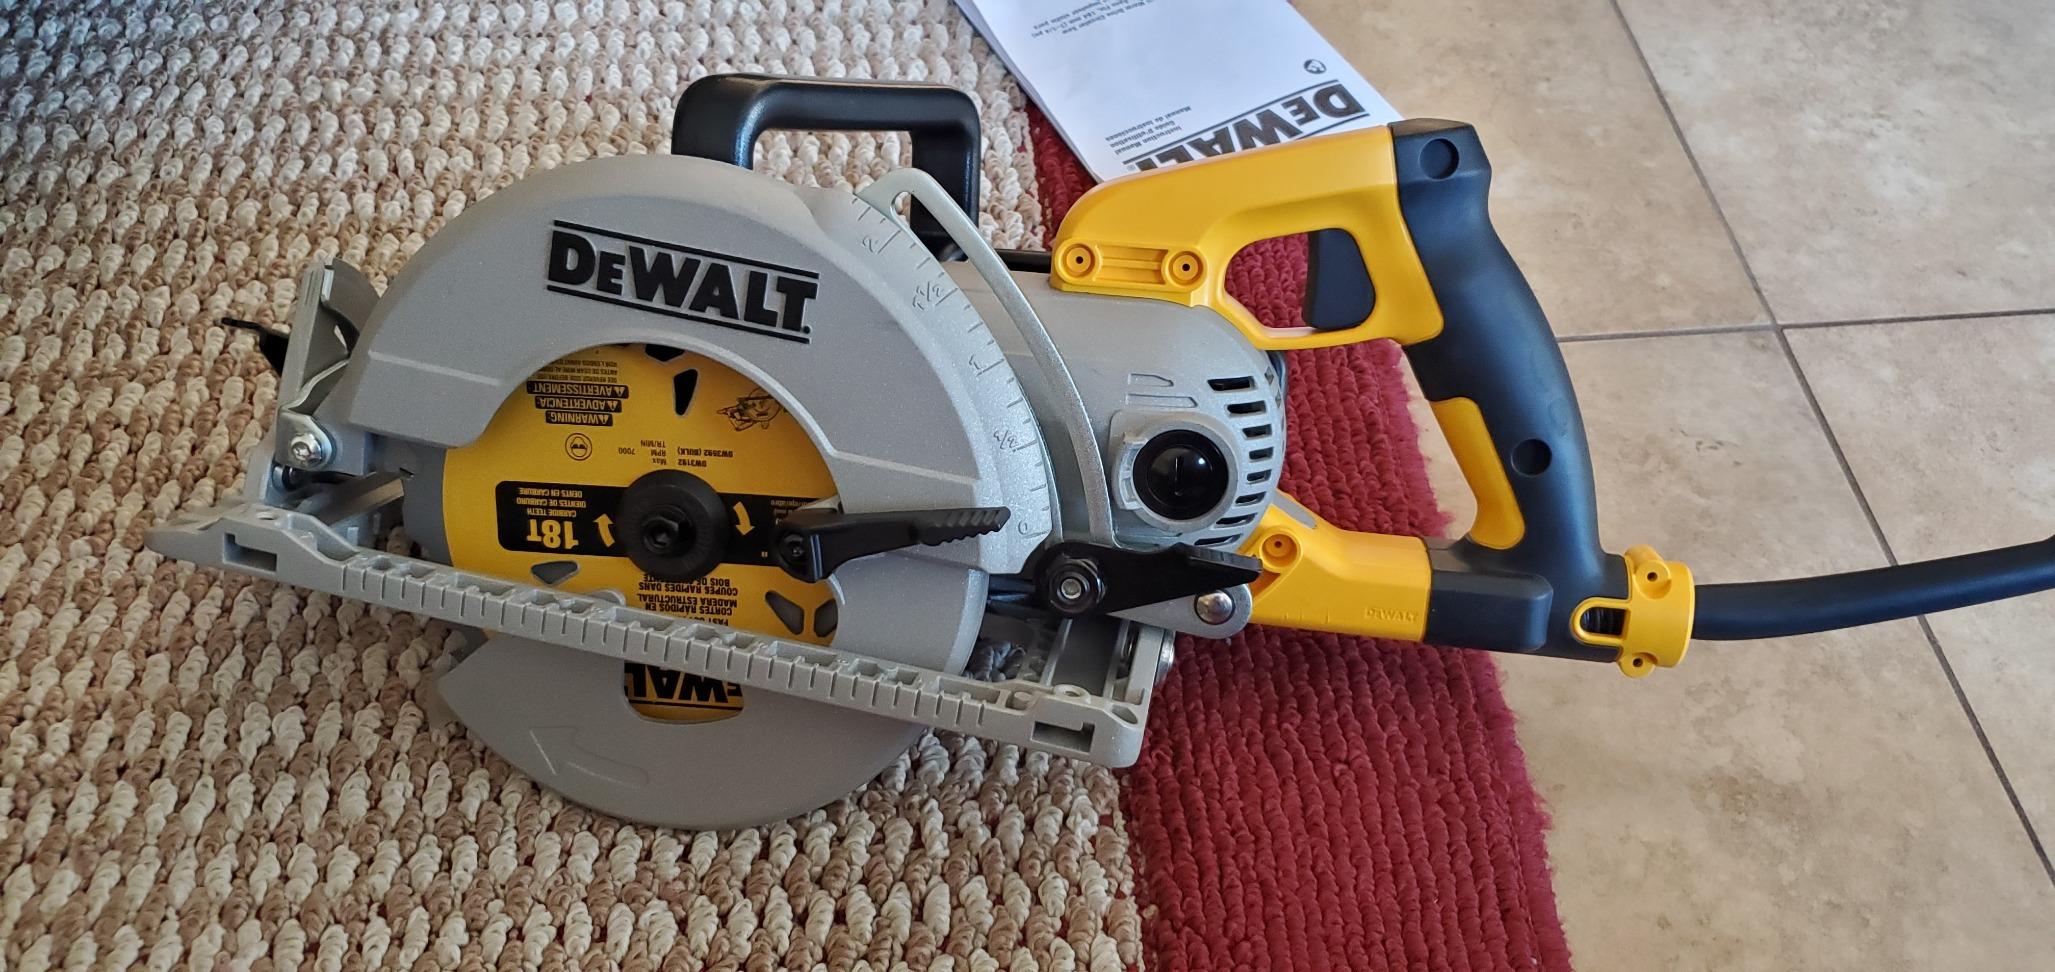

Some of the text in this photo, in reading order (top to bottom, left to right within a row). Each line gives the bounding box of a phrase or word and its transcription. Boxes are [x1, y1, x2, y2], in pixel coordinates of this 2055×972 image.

[1165, 106, 1192, 120] Manual
[1154, 120, 1177, 132] Guide
[1114, 125, 1184, 156] Instruction Manual
[640, 440, 666, 449] TR/MIN
[618, 447, 636, 455] 7000
[652, 458, 667, 466] Max
[526, 508, 548, 516] TEETH
[527, 519, 579, 550] 18T
[710, 577, 731, 587] BOIS
[638, 581, 739, 597] COUPES RAPIDES DANS
[636, 593, 738, 609] MADERA ESTRUCTURAL
[645, 602, 658, 612] EN
[699, 605, 733, 617] CORTES
